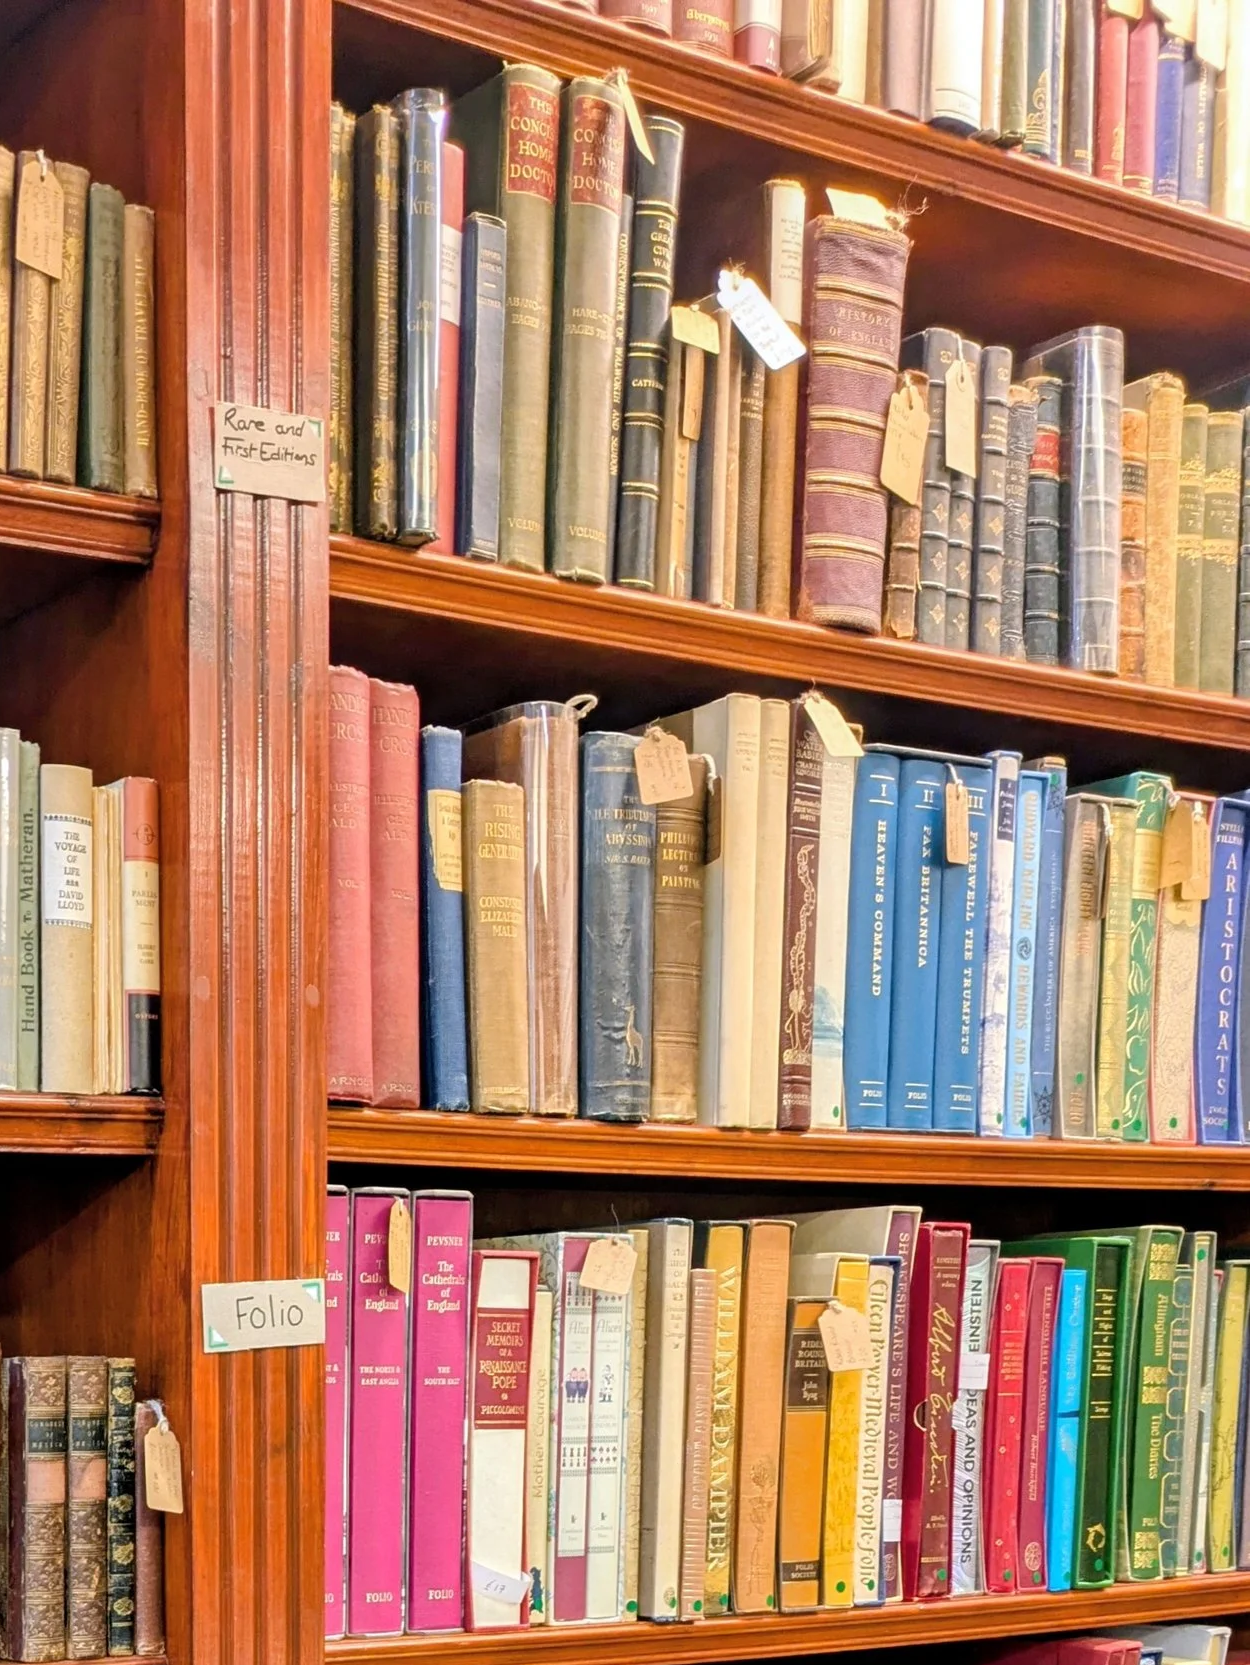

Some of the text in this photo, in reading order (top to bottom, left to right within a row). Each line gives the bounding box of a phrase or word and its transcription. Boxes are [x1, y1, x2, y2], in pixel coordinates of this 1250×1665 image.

[224, 408, 305, 438] Rare and
[221, 435, 317, 466] First Editions
[881, 783, 887, 796] I
[924, 789, 934, 802] II
[968, 795, 983, 809] III
[64, 832, 80, 840] THE
[54, 842, 86, 854] VOYAGE
[67, 855, 78, 863] OF
[64, 866, 80, 876] LIFE
[59, 890, 84, 901] DAVID
[917, 825, 931, 967] PAX BRITANNICA
[58, 900, 85, 911] LLOYD
[872, 820, 886, 996] HEAVEN'S COMMAND
[20, 807, 36, 1032] Hand Book To Matheran.
[961, 831, 977, 1054] FAREWELL THE TRUMPETS
[1217, 852, 1238, 1095] ARISTOCRATS
[426, 1236, 464, 1246] PEVSNER
[436, 1261, 455, 1273] The
[422, 1273, 465, 1286] Cathedrals
[236, 1295, 304, 1329] Folio
[426, 1300, 460, 1313] England
[968, 1279, 983, 1352] EINSTEIN
[491, 1322, 521, 1334] SECRET
[479, 1360, 527, 1375] RENAISSANCE
[492, 1375, 517, 1389] POPE
[705, 1266, 739, 1573] WILLIAM DAMPIER
[534, 1368, 547, 1499] Mother Courage
[428, 1589, 454, 1600] FOLIO
